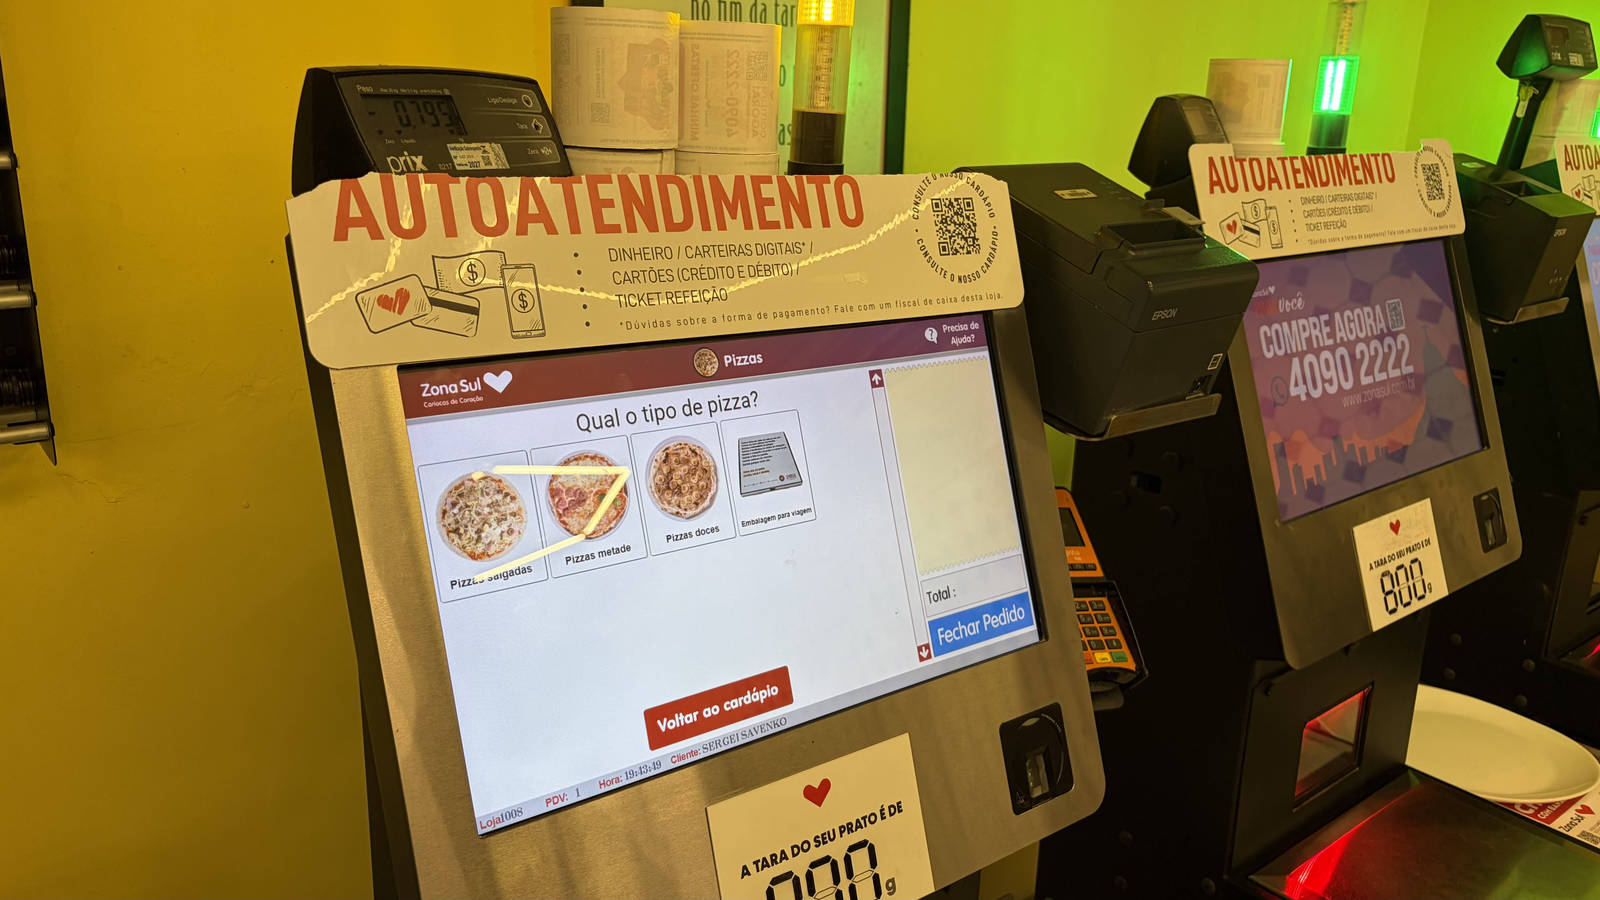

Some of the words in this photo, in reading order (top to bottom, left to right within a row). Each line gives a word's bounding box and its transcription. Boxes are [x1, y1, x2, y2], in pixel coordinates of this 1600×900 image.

[386, 151, 428, 175] prix
[1207, 153, 1396, 194] AUTOATENDIMENTO
[333, 173, 864, 241] AUTOATENDIMENTO
[912, 176, 932, 220] CONSULTE
[966, 176, 996, 218] CARDÁPIO
[1305, 221, 1323, 232] TICKET
[608, 247, 673, 262] DINHEIRO
[685, 243, 753, 259] CARTEIRAS
[917, 238, 948, 279] CONSULTE
[950, 273, 955, 282] O
[958, 270, 981, 284] NOSSO
[980, 230, 999, 274] CARDÁPIO
[612, 266, 674, 285] CARTÕES
[677, 264, 734, 282] (CRÉDITO
[738, 266, 744, 279] E
[748, 262, 793, 278] DÉBITO)
[615, 291, 661, 308] TICKET
[665, 286, 728, 305] REFEIÇÃO
[677, 317, 706, 327] sobre
[722, 313, 752, 322] forma
[757, 311, 768, 320] de
[772, 306, 830, 320] pagamento?
[834, 304, 854, 313] Fale
[857, 303, 876, 311] com
[880, 302, 892, 310] um
[895, 300, 920, 309] fiscal
[936, 296, 958, 305] caixa
[961, 294, 983, 302] desta
[1152, 308, 1178, 321] EPSON
[942, 323, 968, 334] Precisa
[969, 321, 980, 331] de
[1259, 314, 1334, 359] COMPRE
[1334, 304, 1388, 344] AGORA
[951, 334, 976, 347] Ajuda?
[724, 352, 764, 368] Pizzas
[1289, 346, 1355, 401] 4090
[1355, 333, 1415, 386] 2222
[421, 382, 459, 397] Zona
[460, 376, 482, 393] Sul
[423, 400, 450, 408] Cariocas
[450, 398, 459, 406] de
[459, 396, 484, 405] Coração
[576, 408, 620, 433] Qual
[626, 411, 637, 425] o
[641, 404, 677, 425] tipo
[682, 398, 703, 417] de
[707, 390, 759, 418] pizza?
[741, 513, 777, 528] Embalagem
[777, 511, 791, 521] para
[791, 507, 813, 519] viagem
[666, 530, 694, 543] Pizzas
[695, 524, 720, 537] doces
[565, 550, 596, 566] Pizzas
[598, 542, 632, 558] metade
[1369, 562, 1374, 572] A
[1374, 556, 1388, 570] TARA
[1387, 552, 1396, 563] DO
[1396, 548, 1406, 561] SEU
[1405, 543, 1422, 555] PRATO
[1424, 537, 1432, 548] DE
[926, 585, 951, 604] Total
[1380, 557, 1427, 615] 800
[937, 620, 981, 646] Fechar
[982, 603, 1025, 631] Pedido
[656, 708, 699, 733] Voltar
[703, 704, 720, 718] ao
[724, 684, 779, 712] cardápio
[599, 775, 623, 790] Hora:
[624, 759, 662, 781] 19:43:49
[670, 748, 702, 764] Cliente:
[701, 733, 740, 754] SERGEI
[740, 717, 788, 741] SAVENKO
[740, 864, 752, 880] A
[753, 849, 790, 873] TARA
[790, 839, 812, 859] DO
[813, 828, 837, 849] SEU
[838, 812, 878, 839] PRATO
[879, 801, 887, 822] É
[887, 800, 904, 818] DE
[885, 876, 897, 897] g
